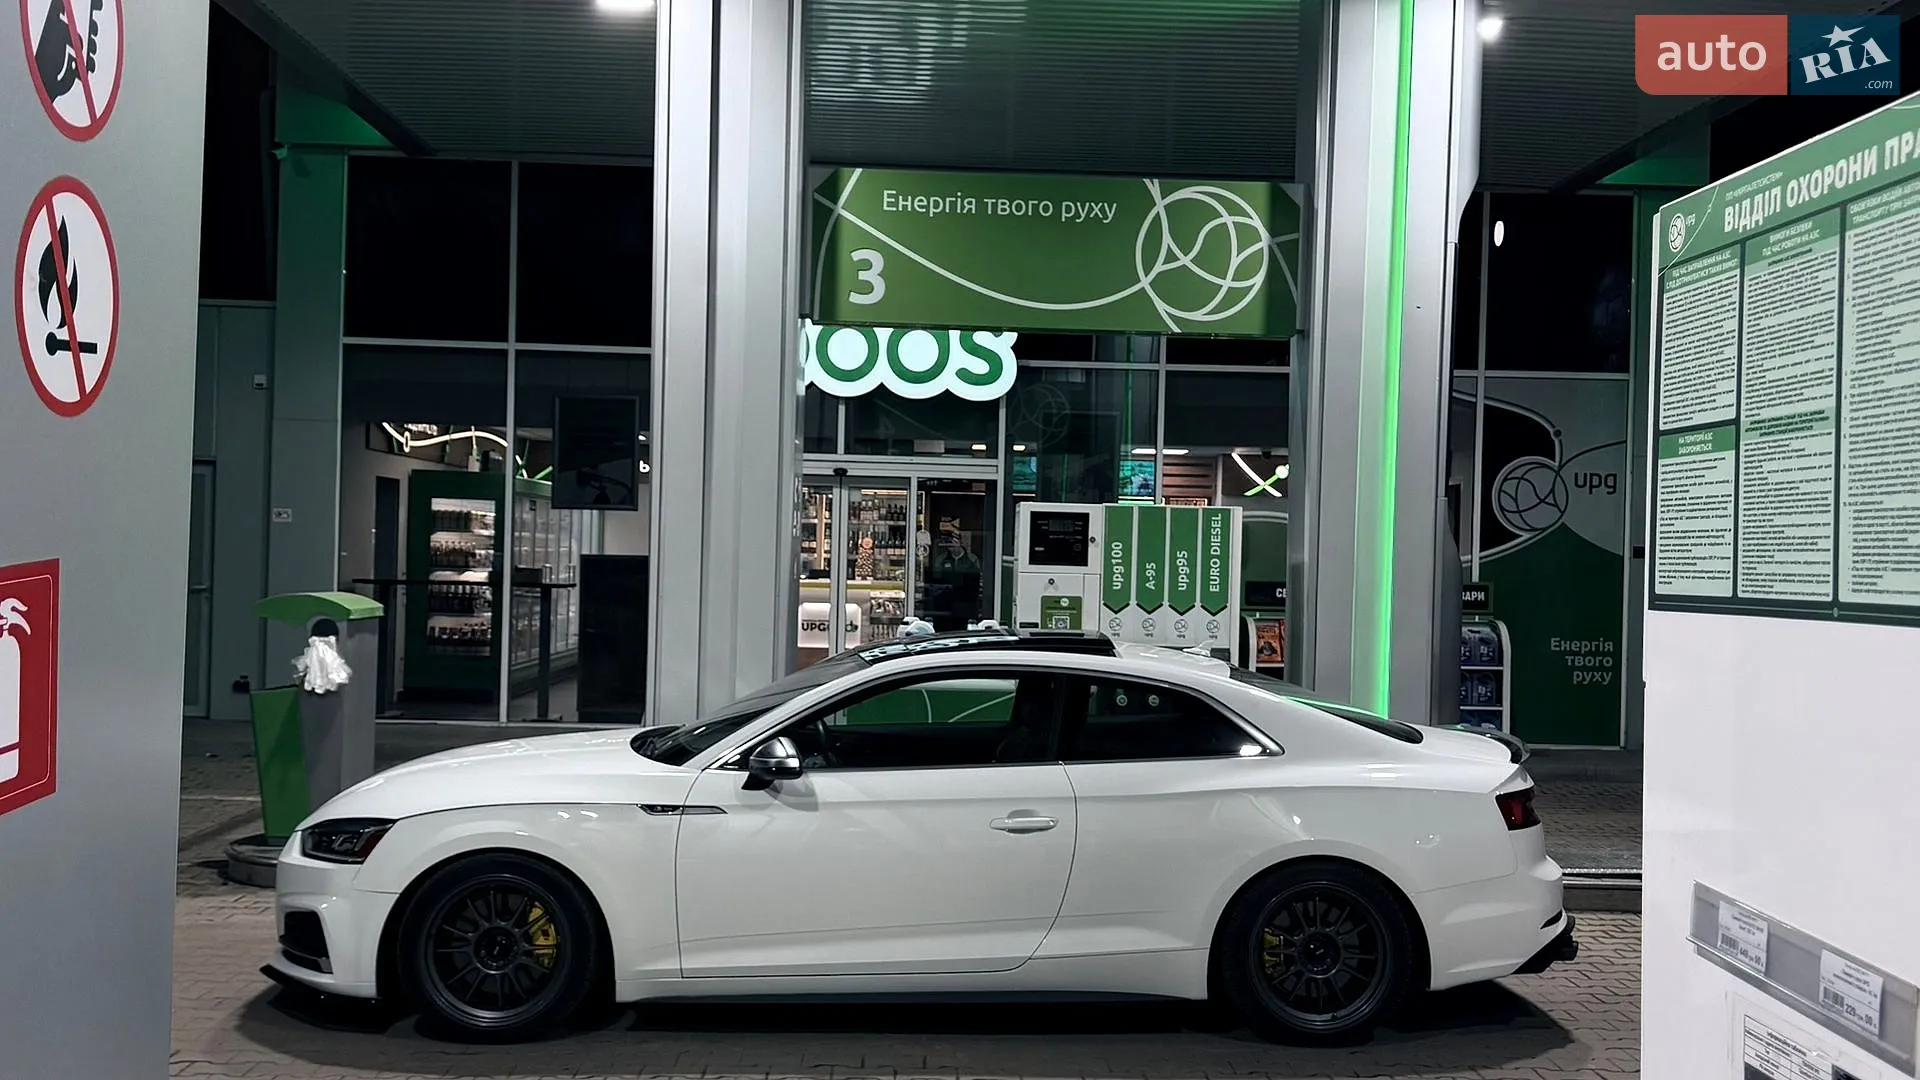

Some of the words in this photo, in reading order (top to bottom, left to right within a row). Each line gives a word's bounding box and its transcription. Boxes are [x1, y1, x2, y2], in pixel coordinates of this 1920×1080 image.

[883, 189, 976, 217] Енергія
[984, 199, 1054, 217] твого
[1061, 201, 1117, 224] руху
[1724, 186, 1781, 233] ВІДДІЛ
[1786, 145, 1878, 208] ОХОРОНИ
[848, 248, 887, 306] 3
[1574, 472, 1618, 495] upg
[1210, 513, 1222, 557] DIESEL
[1111, 541, 1125, 590] upg100
[1176, 550, 1190, 591] upg95
[1209, 558, 1221, 593] EURO
[1551, 637, 1613, 655] Енергія
[1565, 655, 1613, 667] твого
[1573, 671, 1612, 685] руху
